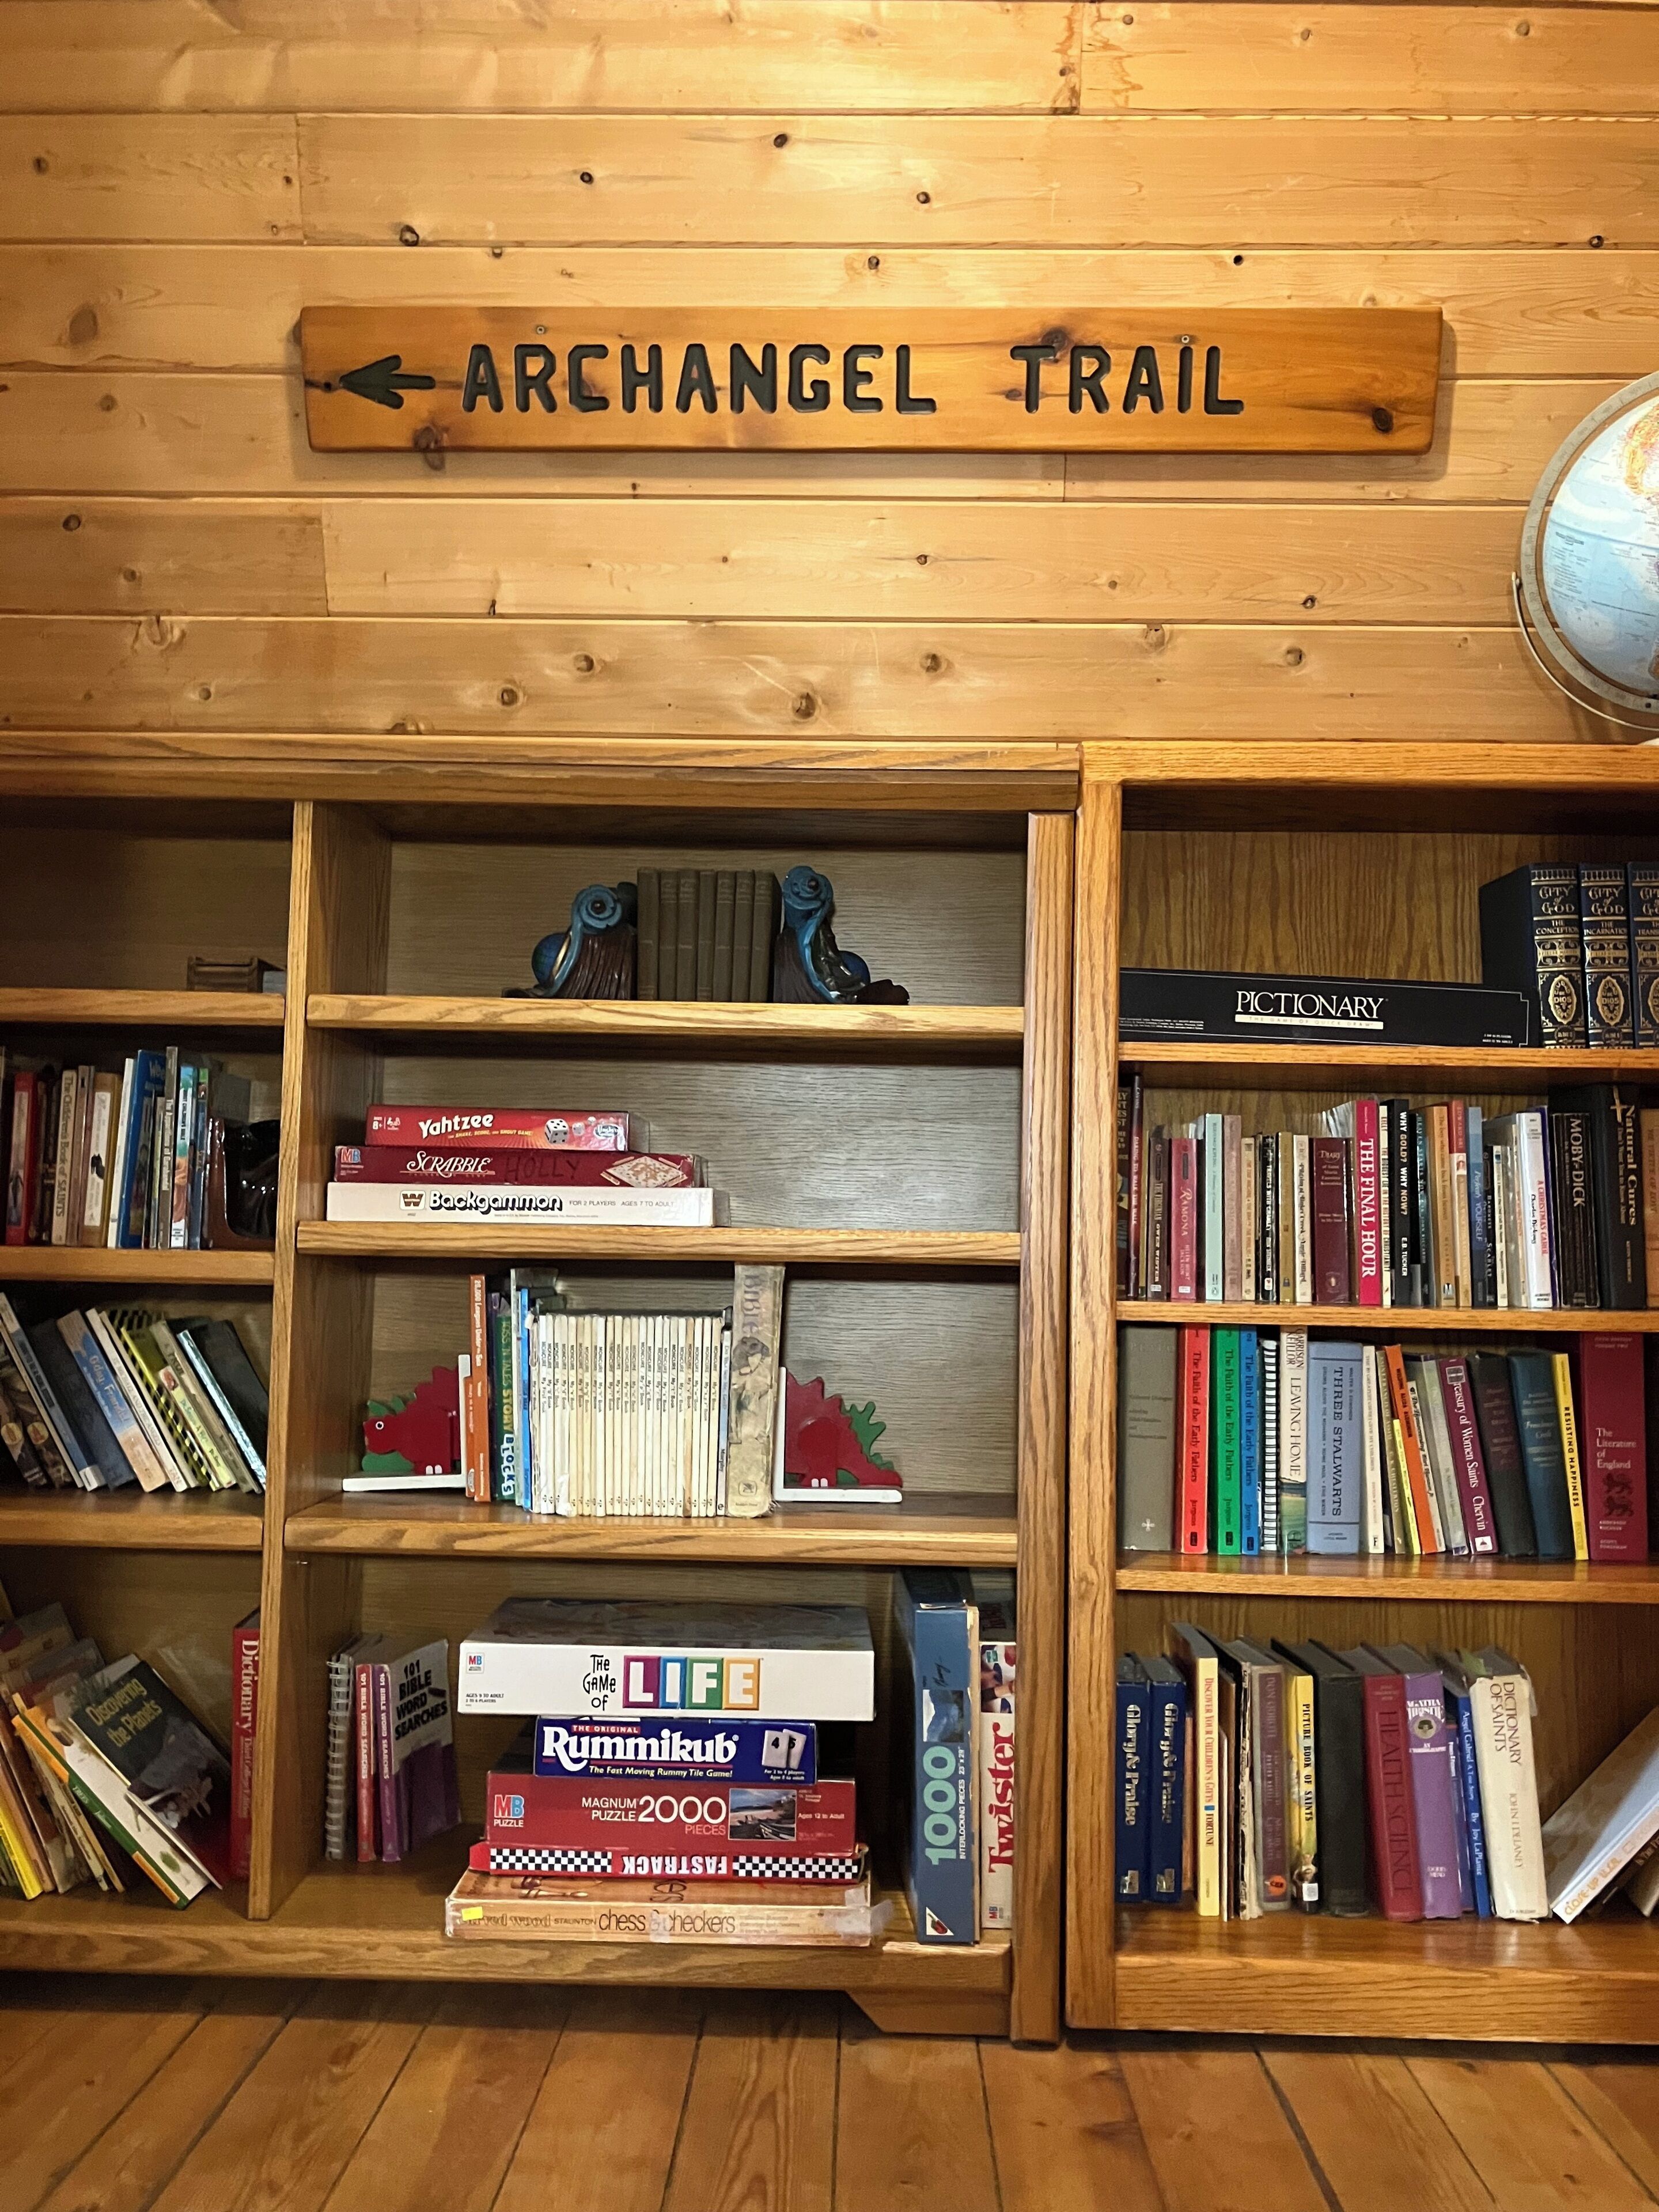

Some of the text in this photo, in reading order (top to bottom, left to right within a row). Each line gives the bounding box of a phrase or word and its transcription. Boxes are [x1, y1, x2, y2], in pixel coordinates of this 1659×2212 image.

[462, 343, 1245, 415] ARCHANGEL TRAIL
[1236, 990, 1383, 1018] PICTIONARY
[419, 1114, 494, 1139] Yahtzee
[1625, 1105, 1638, 1169] Natural
[59, 1142, 70, 1165] Book
[59, 1166, 67, 1177] of
[406, 1150, 492, 1178] SCRABBLE
[504, 1156, 580, 1183] HOLLY
[1569, 1119, 1585, 1207] MOBY-DICK
[56, 1180, 66, 1217] SAINTS
[429, 1191, 563, 1215] Backgammon
[1179, 1186, 1192, 1236] RAMONA
[1359, 1138, 1377, 1278] THE FINAL HOUR
[1537, 1187, 1547, 1230] CHRISTMAS
[1627, 1175, 1638, 1226] Cures
[1475, 1202, 1483, 1242] YOURSELF
[474, 1302, 482, 1329] Leagues
[1245, 1355, 1253, 1373] The
[1286, 1332, 1296, 1365] KEILLOR
[1296, 1328, 1304, 1368] GARRISON
[1245, 1375, 1253, 1397] Faith
[1246, 1400, 1253, 1409] of
[1190, 1351, 1201, 1482] The Faith of the Early Fathers
[1224, 1349, 1234, 1481] The Faith of the Early Fathers
[1290, 1377, 1301, 1476] LEAVING HOME
[1596, 1428, 1613, 1438] The
[502, 1388, 515, 1493] STORY BLOCKS
[1244, 1429, 1253, 1452] Early
[1332, 1367, 1343, 1517] THREE STALWARTS
[1564, 1407, 1574, 1453] RESISTING
[1569, 1457, 1580, 1508] HAPPINESS
[1596, 1438, 1637, 1448] Literature
[1597, 1449, 1606, 1459] of
[1245, 1456, 1253, 1486] Fathers
[1460, 1415, 1487, 1530] of Women Saints Chervin
[1597, 1459, 1631, 1470] England
[403, 1659, 421, 1679] 101
[469, 1656, 482, 1665] MB
[236, 1639, 259, 1736] Dictionary
[399, 1669, 432, 1702] BIBLE
[628, 1659, 756, 1706] LIFE
[85, 1677, 147, 1726] Discovering
[395, 1699, 448, 1741] SEARCHES
[396, 1692, 427, 1721] WORD
[1490, 1684, 1507, 1752] OF SAINTS
[106, 1699, 162, 1748] the Planets
[1122, 1705, 1141, 1753] Glory
[1302, 1703, 1310, 1740] PICTURE
[1462, 1711, 1474, 1762] Angel Gabriel
[1502, 1682, 1522, 1766] DICTIONARY
[542, 1726, 737, 1771] Rummikub
[771, 1737, 780, 1749] 4
[1378, 1710, 1404, 1798] HEALTH
[589, 1766, 604, 1774] The
[607, 1766, 623, 1774] Fast
[624, 1767, 655, 1777] Moving
[657, 1768, 687, 1778] Rummy
[706, 1769, 733, 1778] Game!
[1205, 1677, 1215, 1847] DISCOVER YOUR CHILDREN'S GIFTS FORTUNE
[1304, 1774, 1312, 1785] OF
[494, 1794, 525, 1819] MB
[581, 1796, 726, 1824] MAGNUM 2000
[592, 1810, 636, 1821] PUZZLE
[923, 1745, 957, 1865] 1000
[988, 1722, 1014, 1873] Twister
[1125, 1772, 1139, 1825] Praise
[1305, 1790, 1313, 1822] SAINTS
[493, 1819, 524, 1828] PUZZLE
[684, 1824, 726, 1836] PIECES
[1471, 1828, 1482, 1841] Joy
[622, 1855, 728, 1875] FASTRACK
[1387, 1804, 1412, 1896] SCIENCE
[1510, 1826, 1522, 1869] DELANEY
[554, 1908, 646, 1933] STAUNTON chess
